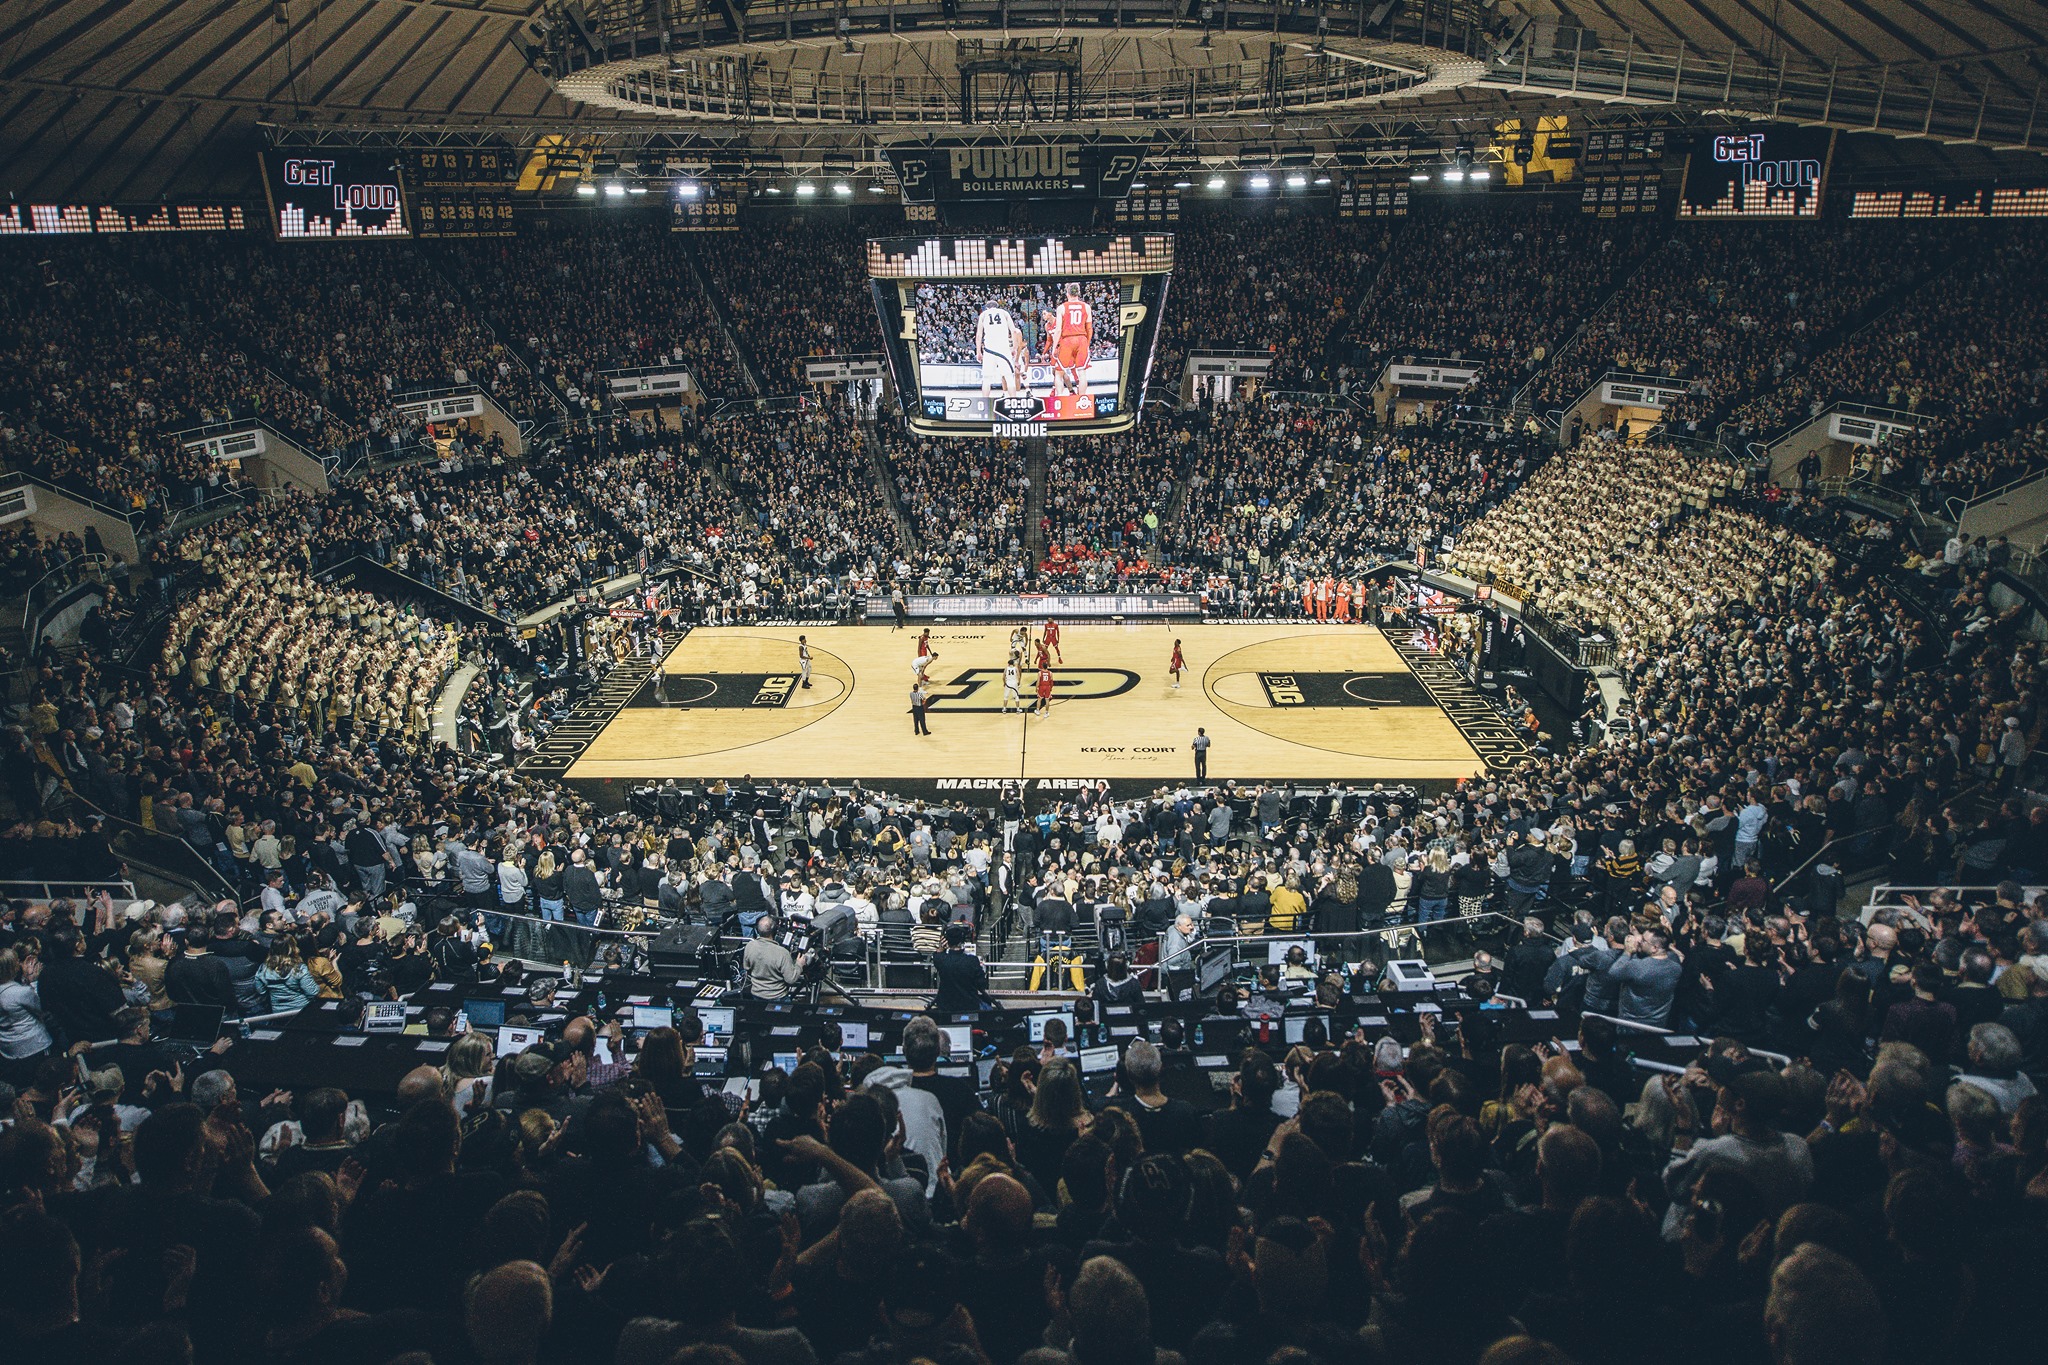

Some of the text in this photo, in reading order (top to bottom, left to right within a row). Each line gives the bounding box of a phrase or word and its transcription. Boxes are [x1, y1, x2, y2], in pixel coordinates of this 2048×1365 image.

[1714, 134, 1764, 161] GET
[421, 154, 437, 168] 27
[443, 154, 456, 168] 13
[465, 155, 473, 168] 7
[480, 155, 496, 169] 23
[950, 143, 1079, 179] PURDUE
[284, 159, 335, 186] GET
[903, 160, 927, 186] P
[1103, 155, 1137, 181] P
[1743, 159, 1820, 187] LOUD
[963, 180, 1069, 191] BOILERMAKERS
[334, 185, 398, 209] LOUD
[420, 206, 434, 220] 19
[440, 206, 456, 219] 32
[459, 206, 475, 219] 35
[478, 206, 494, 219] 43
[497, 206, 513, 219] 42
[674, 204, 682, 215] 4
[688, 204, 702, 215] 25
[706, 204, 720, 215] 33
[723, 204, 737, 215] 50
[904, 205, 936, 221] 1932
[988, 313, 1002, 325] 14
[1069, 310, 1082, 325] 10
[923, 399, 945, 407] Anthem
[977, 401, 984, 411] 0
[1004, 399, 1034, 409] 20:00
[1054, 400, 1062, 410] 0
[993, 424, 1047, 437] PURDUE
[908, 668, 1141, 713] P
[936, 779, 1111, 790] MACKEY ARENA
[307, 894, 332, 906] LANDMARK
